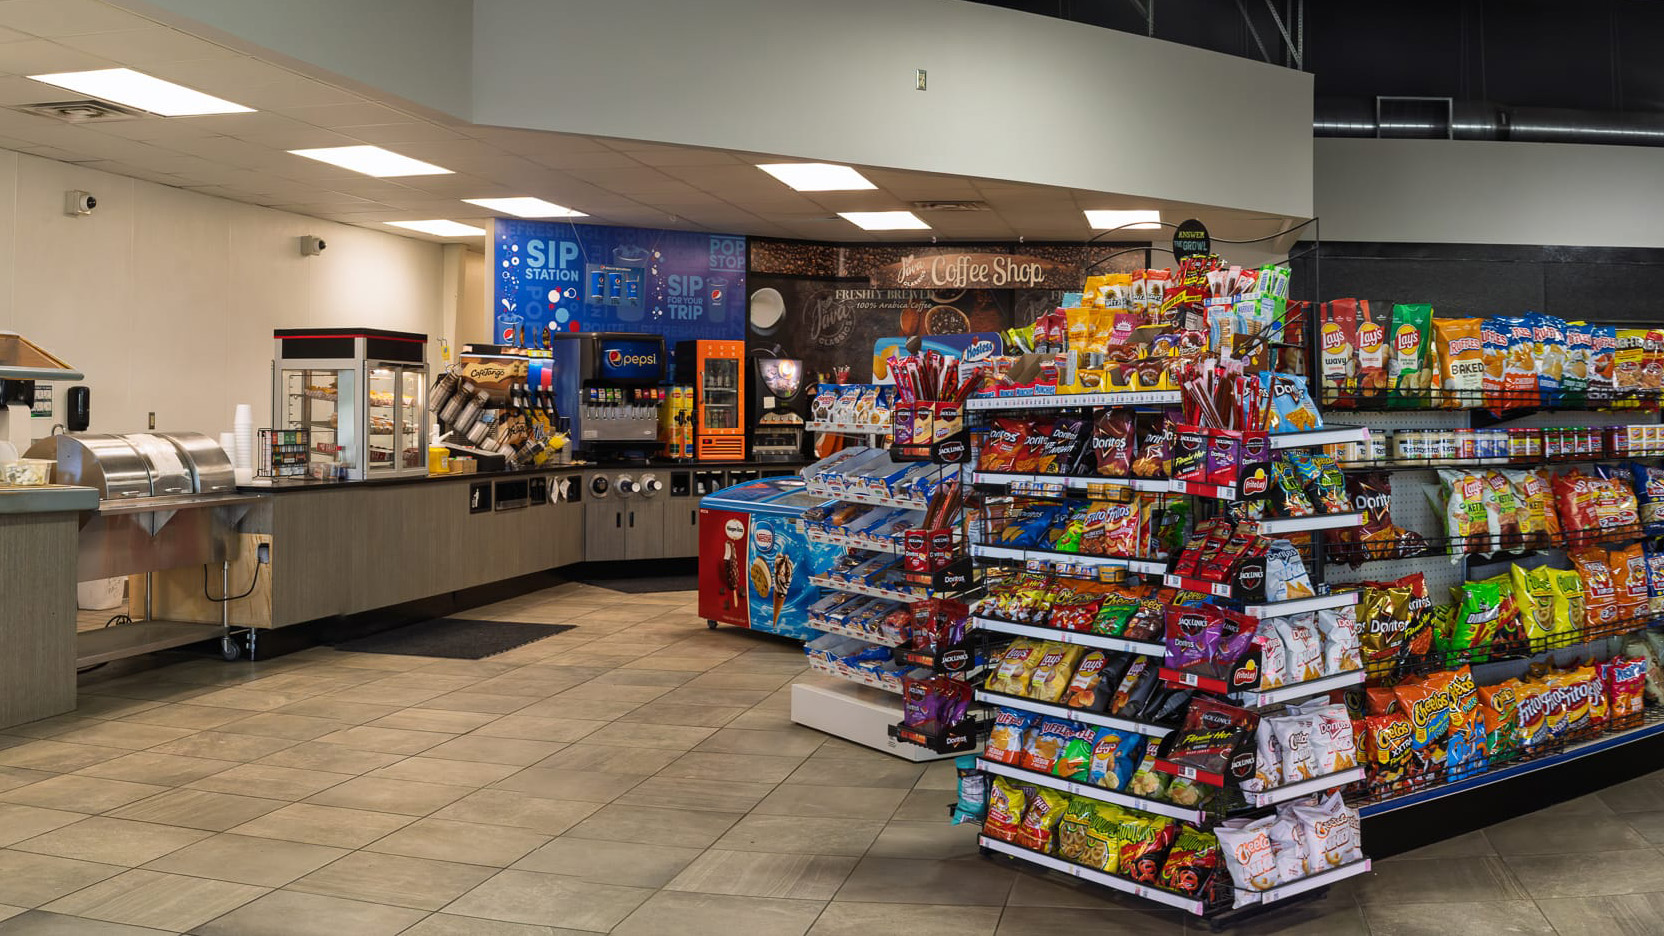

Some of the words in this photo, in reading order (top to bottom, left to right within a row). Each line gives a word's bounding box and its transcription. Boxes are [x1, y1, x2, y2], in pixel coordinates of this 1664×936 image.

[1178, 231, 1205, 239] ANSWER
[710, 239, 745, 256] POP
[1183, 240, 1208, 251] GROWL
[526, 239, 579, 269] SIP
[709, 254, 745, 269] STOP
[525, 268, 579, 282] STATION
[932, 256, 988, 287] Coffee
[993, 256, 1045, 288] Shop
[667, 274, 704, 297] SIP
[667, 296, 682, 304] FOR
[683, 297, 703, 306] YOUR
[835, 290, 883, 300] FRESHLY
[887, 290, 935, 300] BREWED
[668, 304, 703, 320] TRIP
[879, 301, 907, 309] Arabica
[910, 301, 931, 313] Coffee
[1322, 330, 1345, 350] Lay's
[1360, 328, 1382, 347] Lay's
[1398, 332, 1418, 349] Lay's
[966, 343, 994, 360] Hostess
[1450, 337, 1481, 355] RUFFLES
[623, 354, 656, 366] pepsi
[1451, 362, 1484, 375] BAKED
[1053, 429, 1078, 439] Doritos
[950, 445, 965, 453] LINK'S
[1092, 437, 1126, 449] Doritos
[1464, 480, 1483, 496] Lay's
[1489, 474, 1507, 490] Lay's
[1107, 506, 1130, 523] Fritos
[944, 575, 965, 584] Doritos
[1239, 572, 1251, 580] JACK
[1251, 571, 1264, 579] LINK'S
[1178, 618, 1192, 626] JACK
[1192, 619, 1207, 627] LINK'S
[1370, 619, 1409, 633] Doritos
[1174, 638, 1194, 648] Doritos
[953, 653, 968, 661] LINK'S
[1005, 649, 1027, 661] Lay's
[1040, 653, 1063, 667] Lay's
[1079, 658, 1103, 672] Lay's
[1127, 662, 1146, 676] Lay's
[1413, 692, 1449, 728] Cheetos
[1320, 722, 1351, 736] Doritos
[946, 735, 967, 745] Doritos
[1095, 741, 1117, 754] Lay's
[1231, 761, 1243, 770] JACK
[1242, 757, 1255, 766] LINK'S
[1315, 813, 1350, 839] Cheetos
